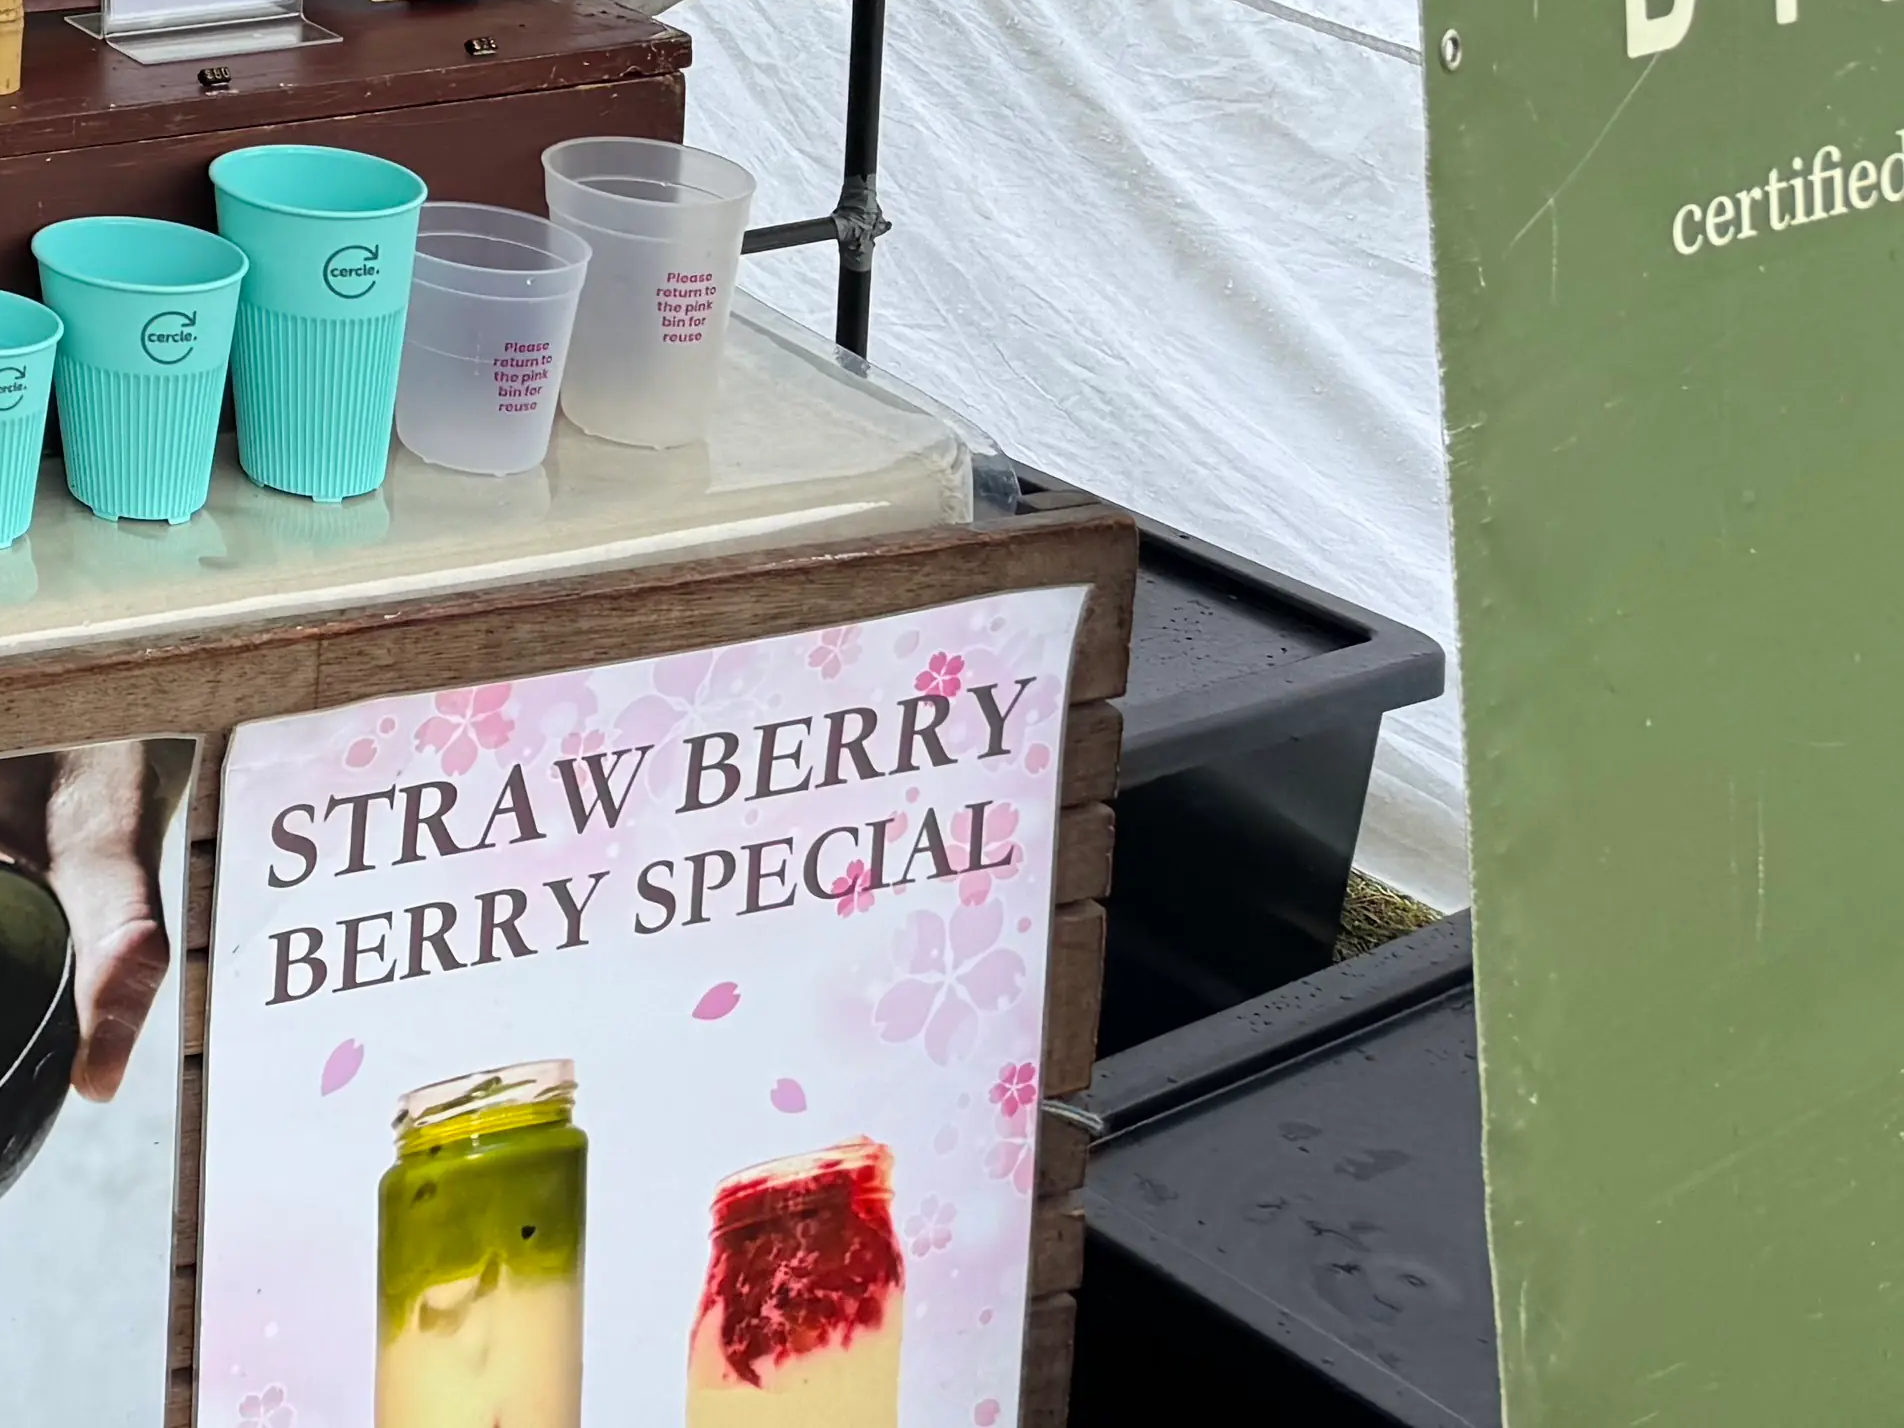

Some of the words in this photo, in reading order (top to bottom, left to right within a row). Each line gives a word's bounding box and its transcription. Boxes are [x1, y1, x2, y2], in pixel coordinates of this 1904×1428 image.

[666, 272, 712, 283] Please
[656, 287, 702, 298] return
[704, 285, 716, 296] to
[657, 301, 682, 313] the
[685, 300, 713, 315] pink
[662, 316, 685, 328] bin
[688, 315, 706, 327] for
[663, 332, 702, 343] reuse
[504, 342, 549, 353] Please
[493, 356, 539, 368] return
[542, 354, 552, 365] to
[494, 371, 518, 383] the
[521, 369, 548, 385] pink
[498, 386, 522, 397] bin
[524, 385, 543, 396] for
[498, 402, 537, 412] reuse
[267, 743, 654, 889] STRAW
[676, 675, 1037, 816] BERRY
[265, 871, 609, 1006] BERRY
[633, 798, 1015, 936] SPECIAL
